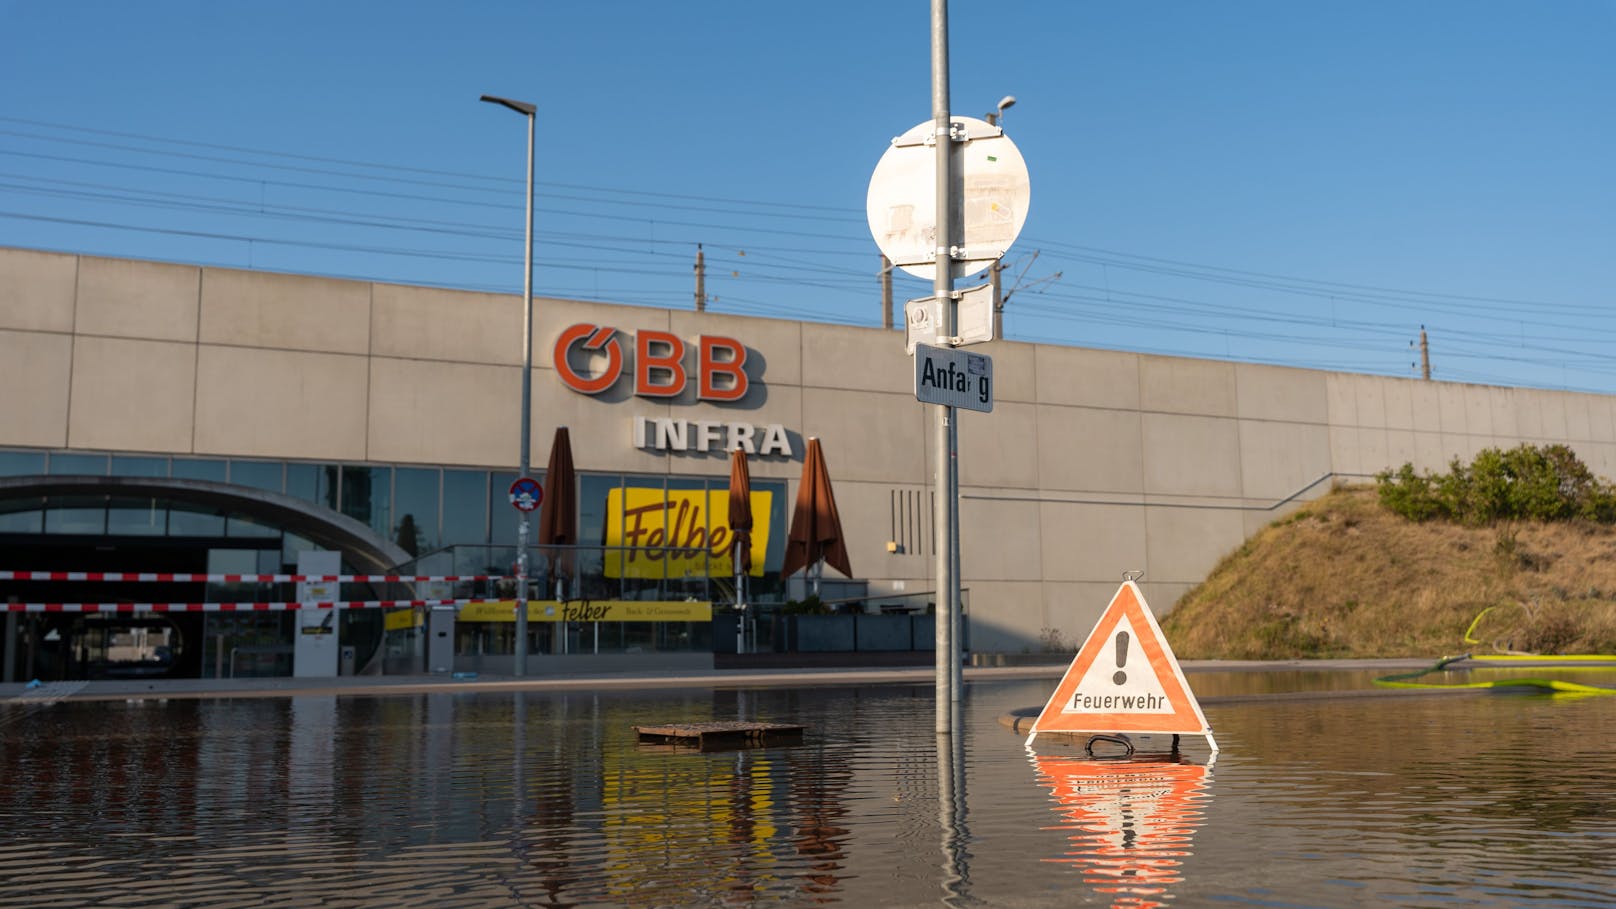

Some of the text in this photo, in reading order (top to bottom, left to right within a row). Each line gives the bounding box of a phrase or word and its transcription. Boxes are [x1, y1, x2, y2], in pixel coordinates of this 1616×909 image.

[553, 323, 748, 401] ÖBB
[921, 357, 989, 403] Anfag
[635, 416, 792, 455] INFRA
[624, 498, 734, 563] Felbe
[1073, 693, 1165, 710] Feuerwehr
